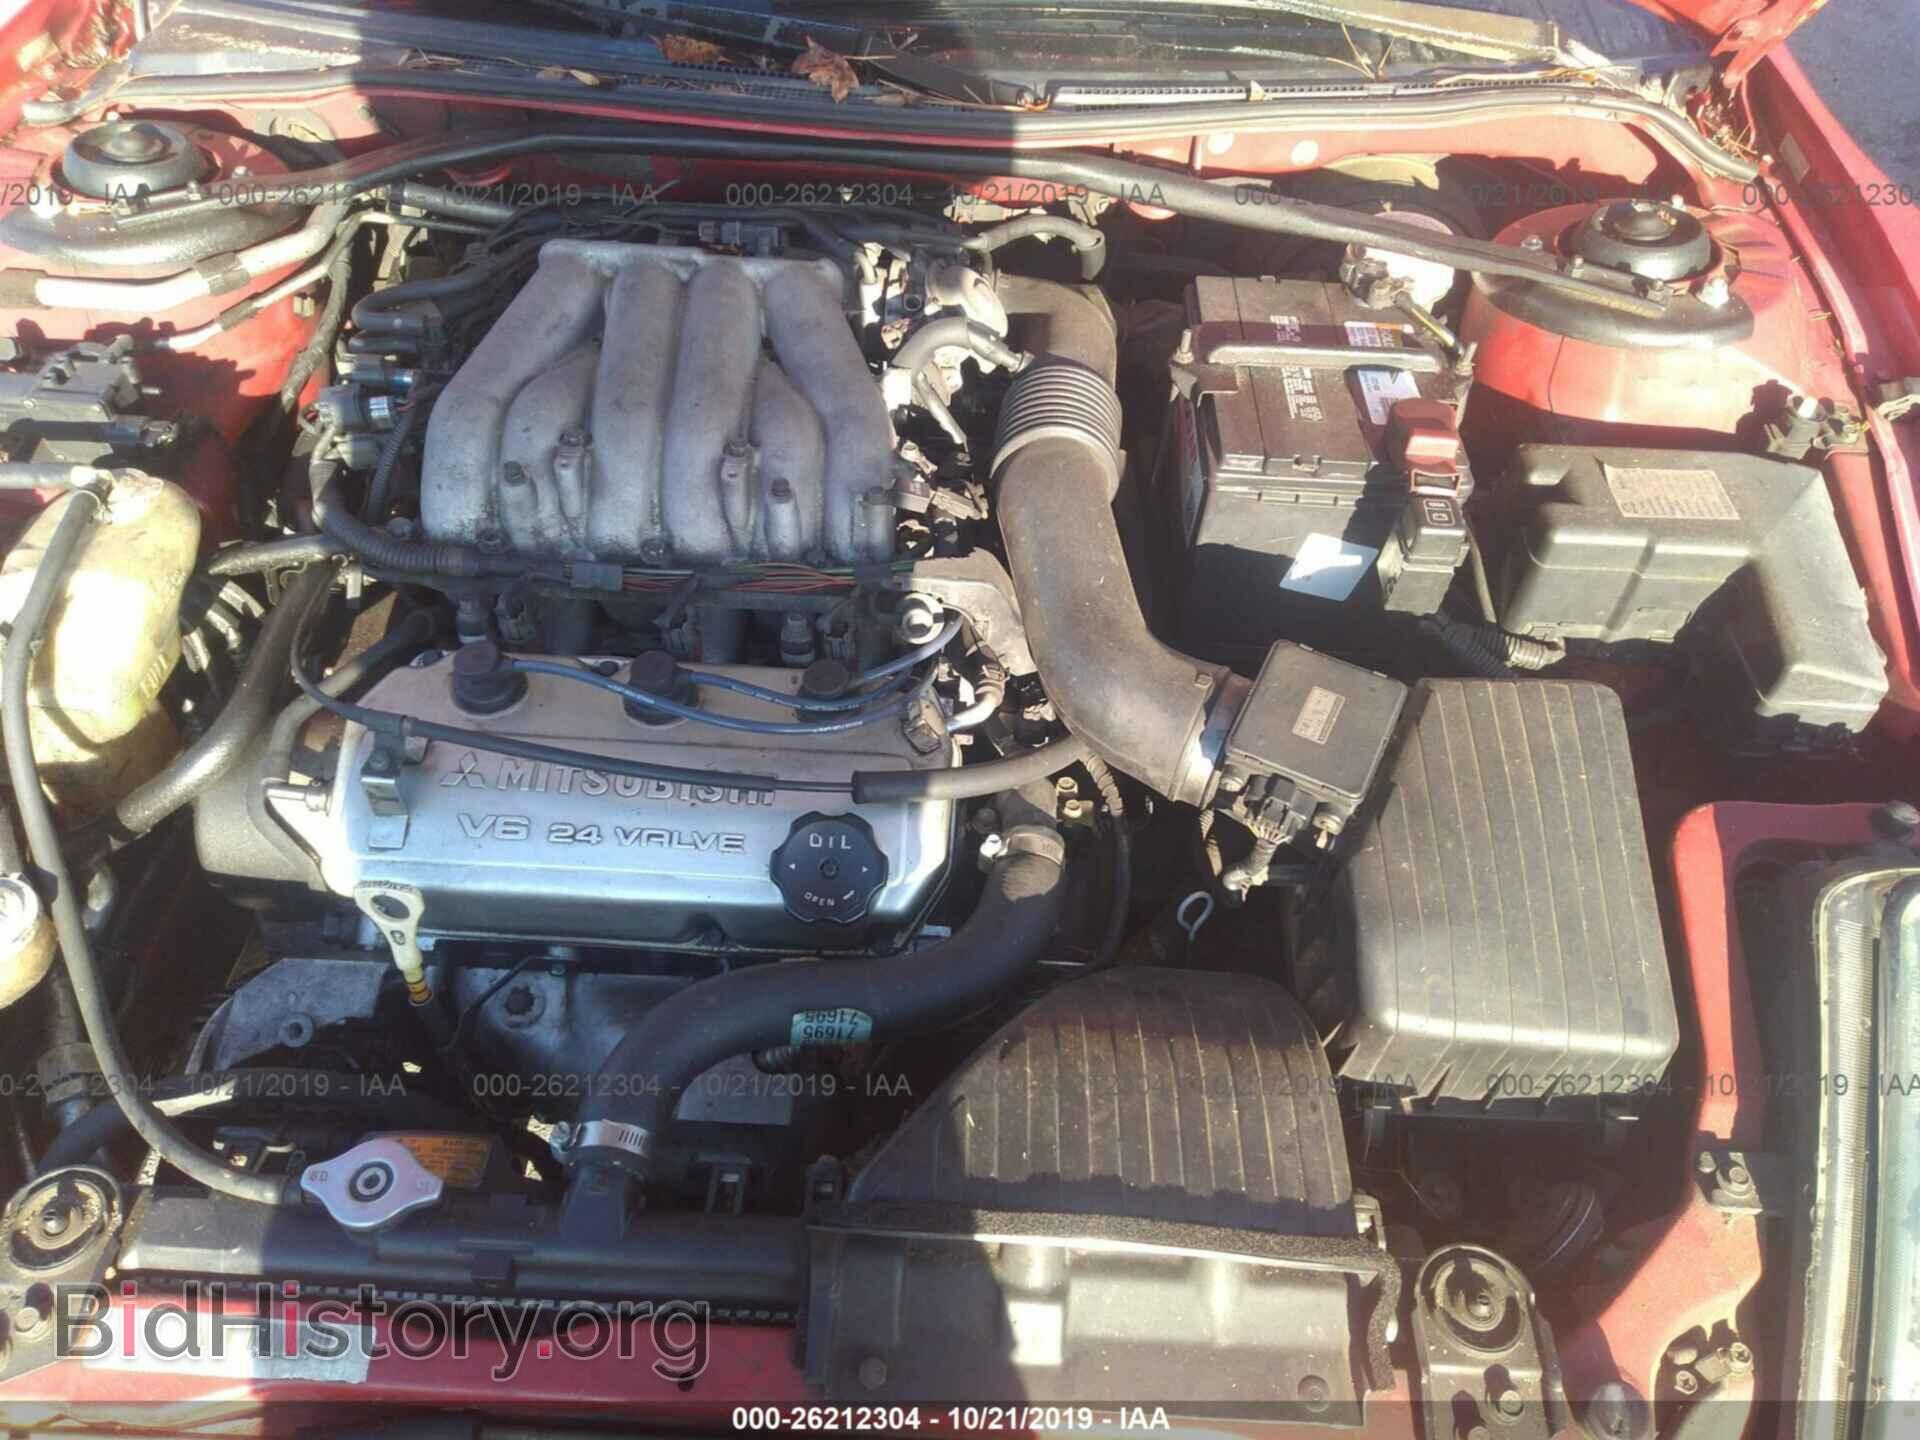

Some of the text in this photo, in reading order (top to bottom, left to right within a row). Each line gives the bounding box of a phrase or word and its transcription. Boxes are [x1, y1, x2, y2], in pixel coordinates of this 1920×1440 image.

[457, 813, 745, 853] V6 24 VALVE
[808, 832, 852, 850] OIL
[803, 891, 835, 907] OPEN
[803, 1024, 858, 1040] 71695
